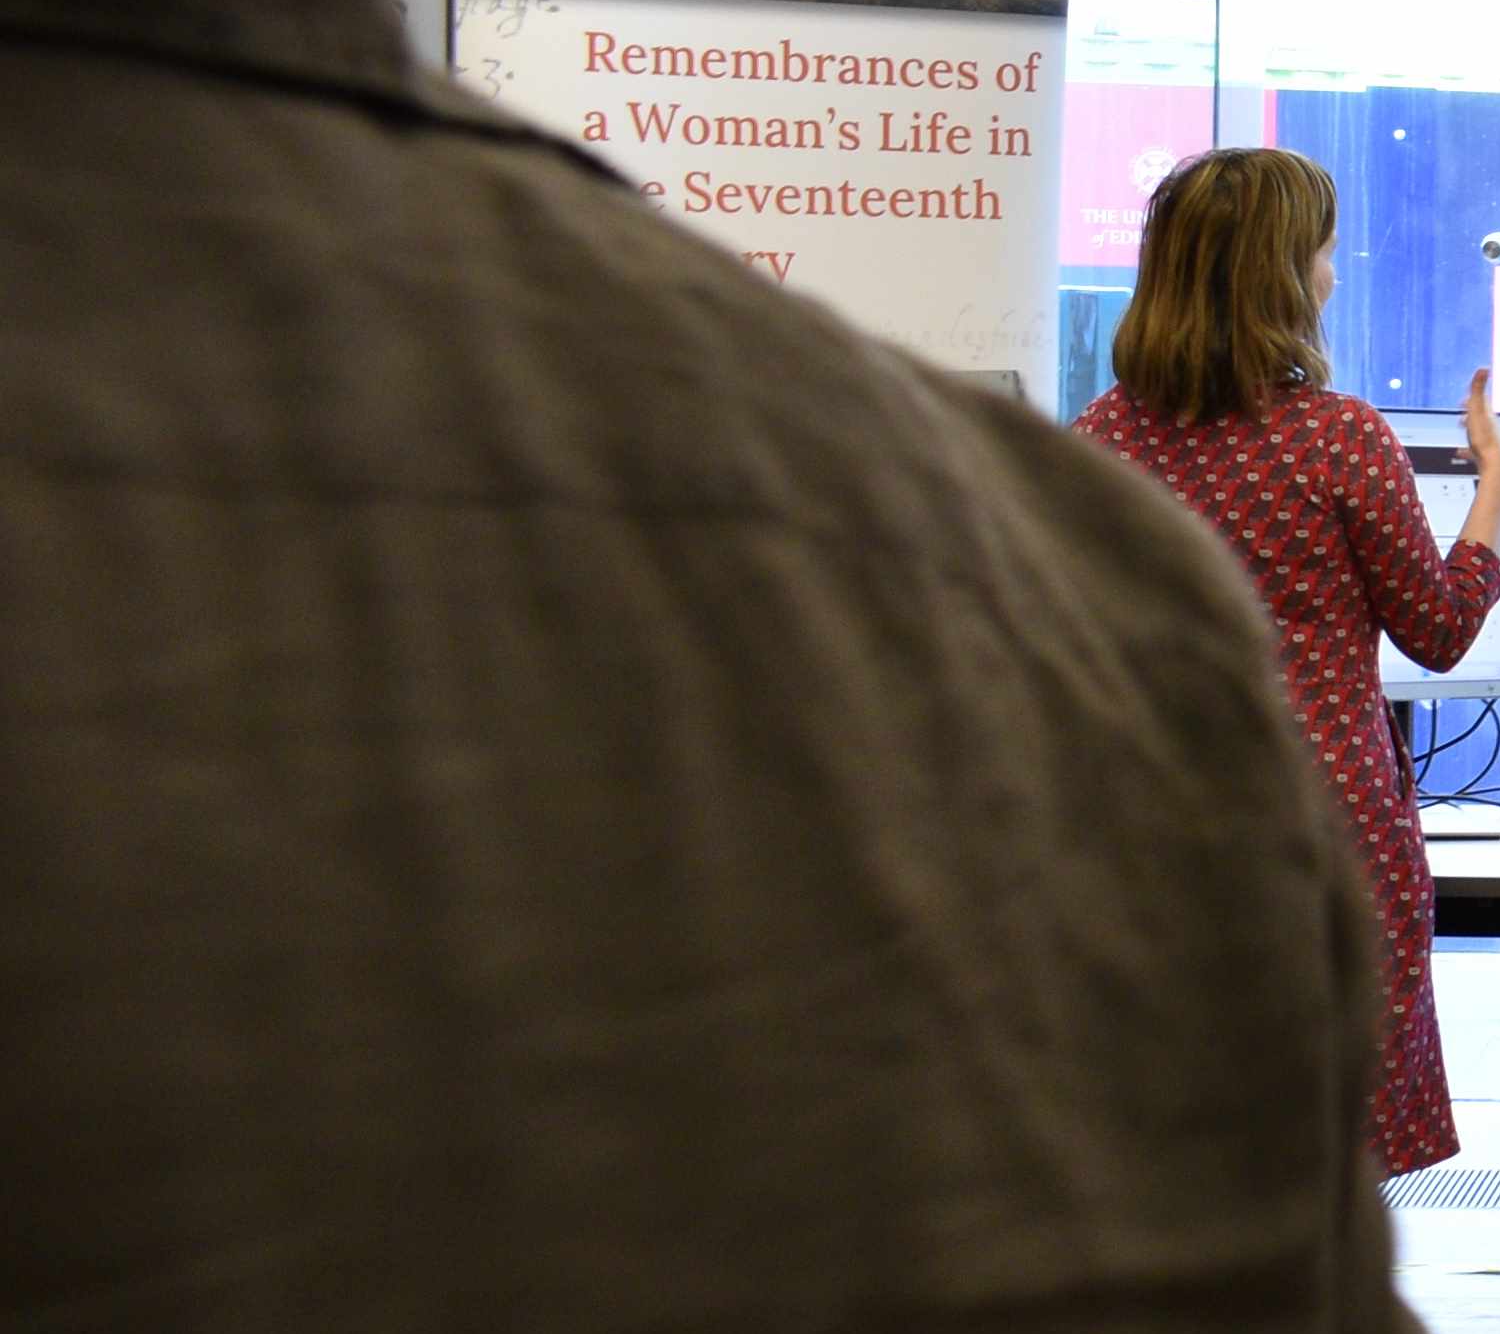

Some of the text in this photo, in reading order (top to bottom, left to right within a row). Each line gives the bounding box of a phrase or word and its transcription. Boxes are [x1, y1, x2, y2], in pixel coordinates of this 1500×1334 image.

[583, 33, 1043, 92] Remembrances of
[581, 103, 1032, 156] a Woman's Life in
[681, 173, 1004, 226] Seventeenth
